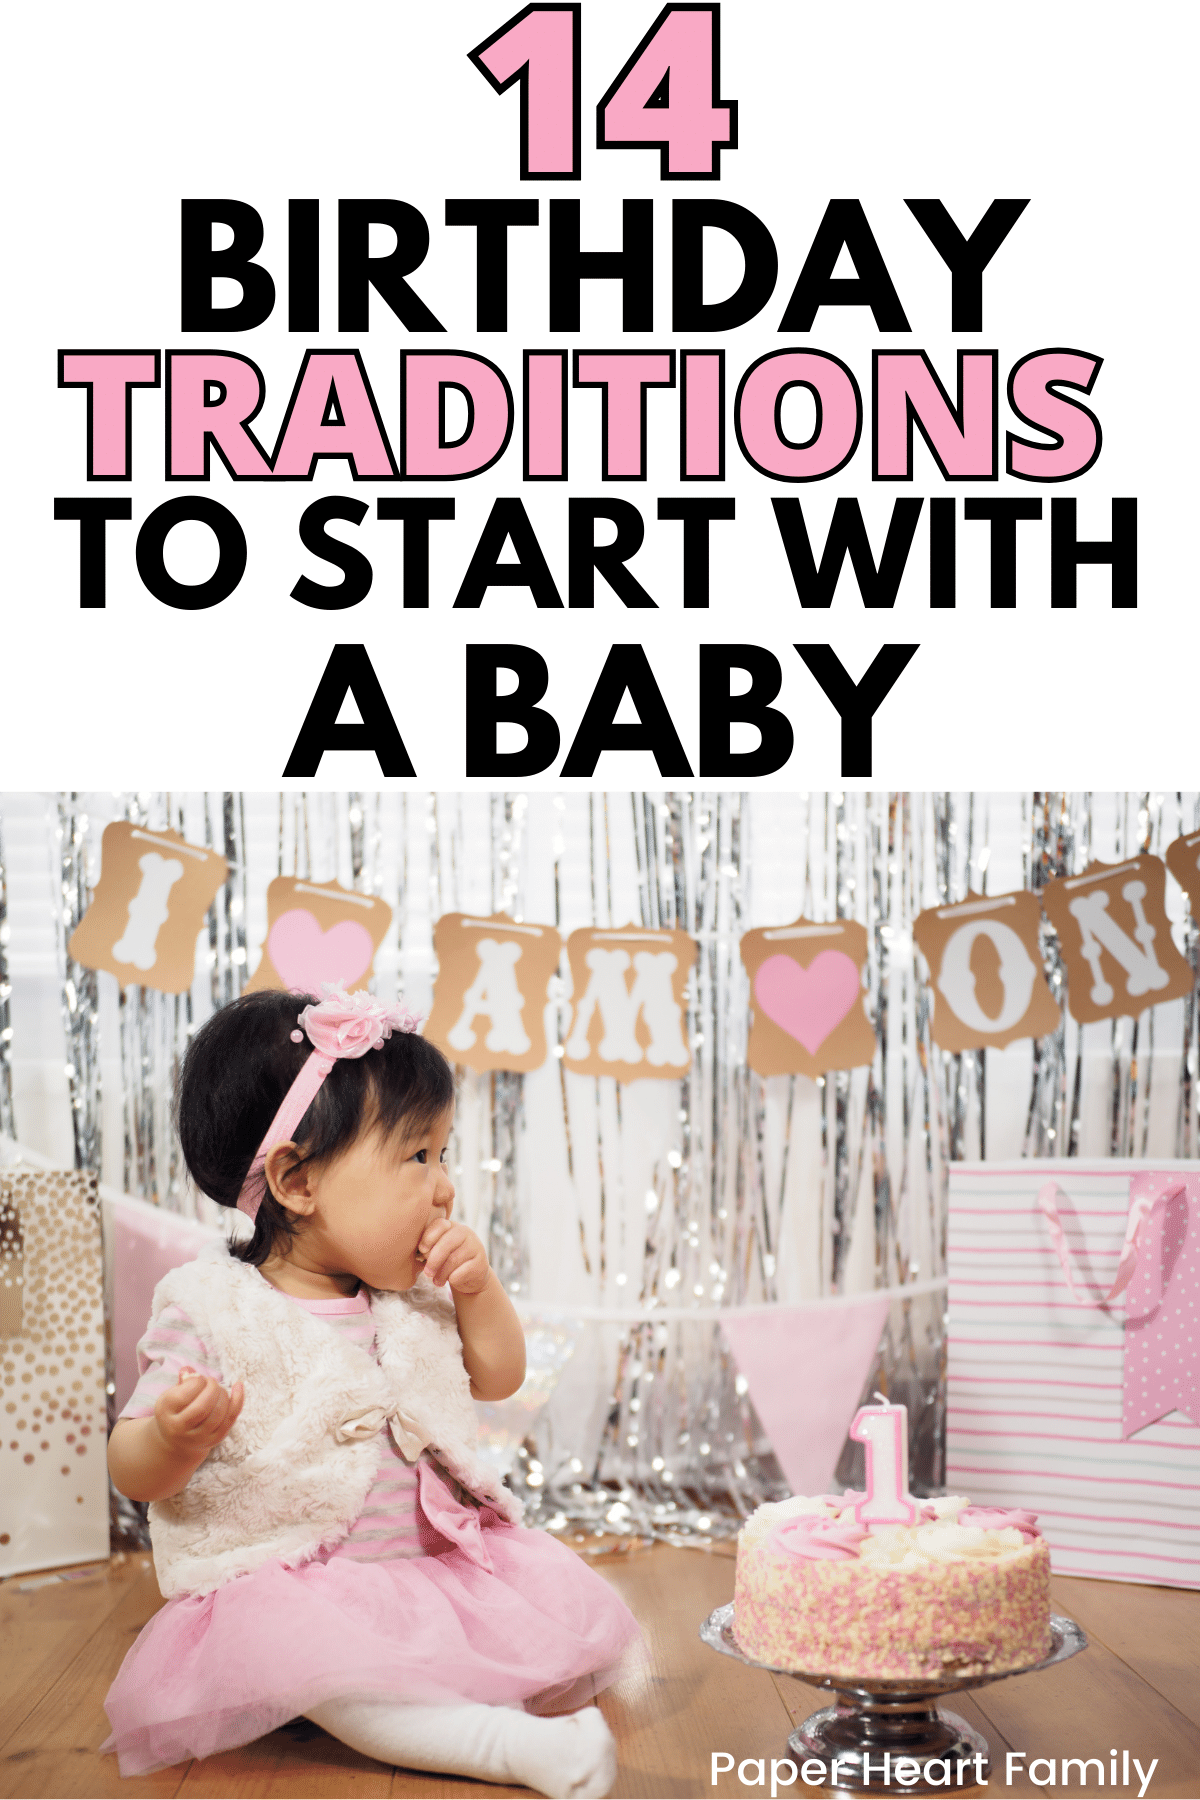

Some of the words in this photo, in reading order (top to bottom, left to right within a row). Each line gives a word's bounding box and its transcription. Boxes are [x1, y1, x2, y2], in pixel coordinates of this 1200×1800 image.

[111, 851, 184, 970] I
[447, 938, 690, 1067] AM
[937, 854, 1200, 1033] ON
[849, 1403, 920, 1525] 1
